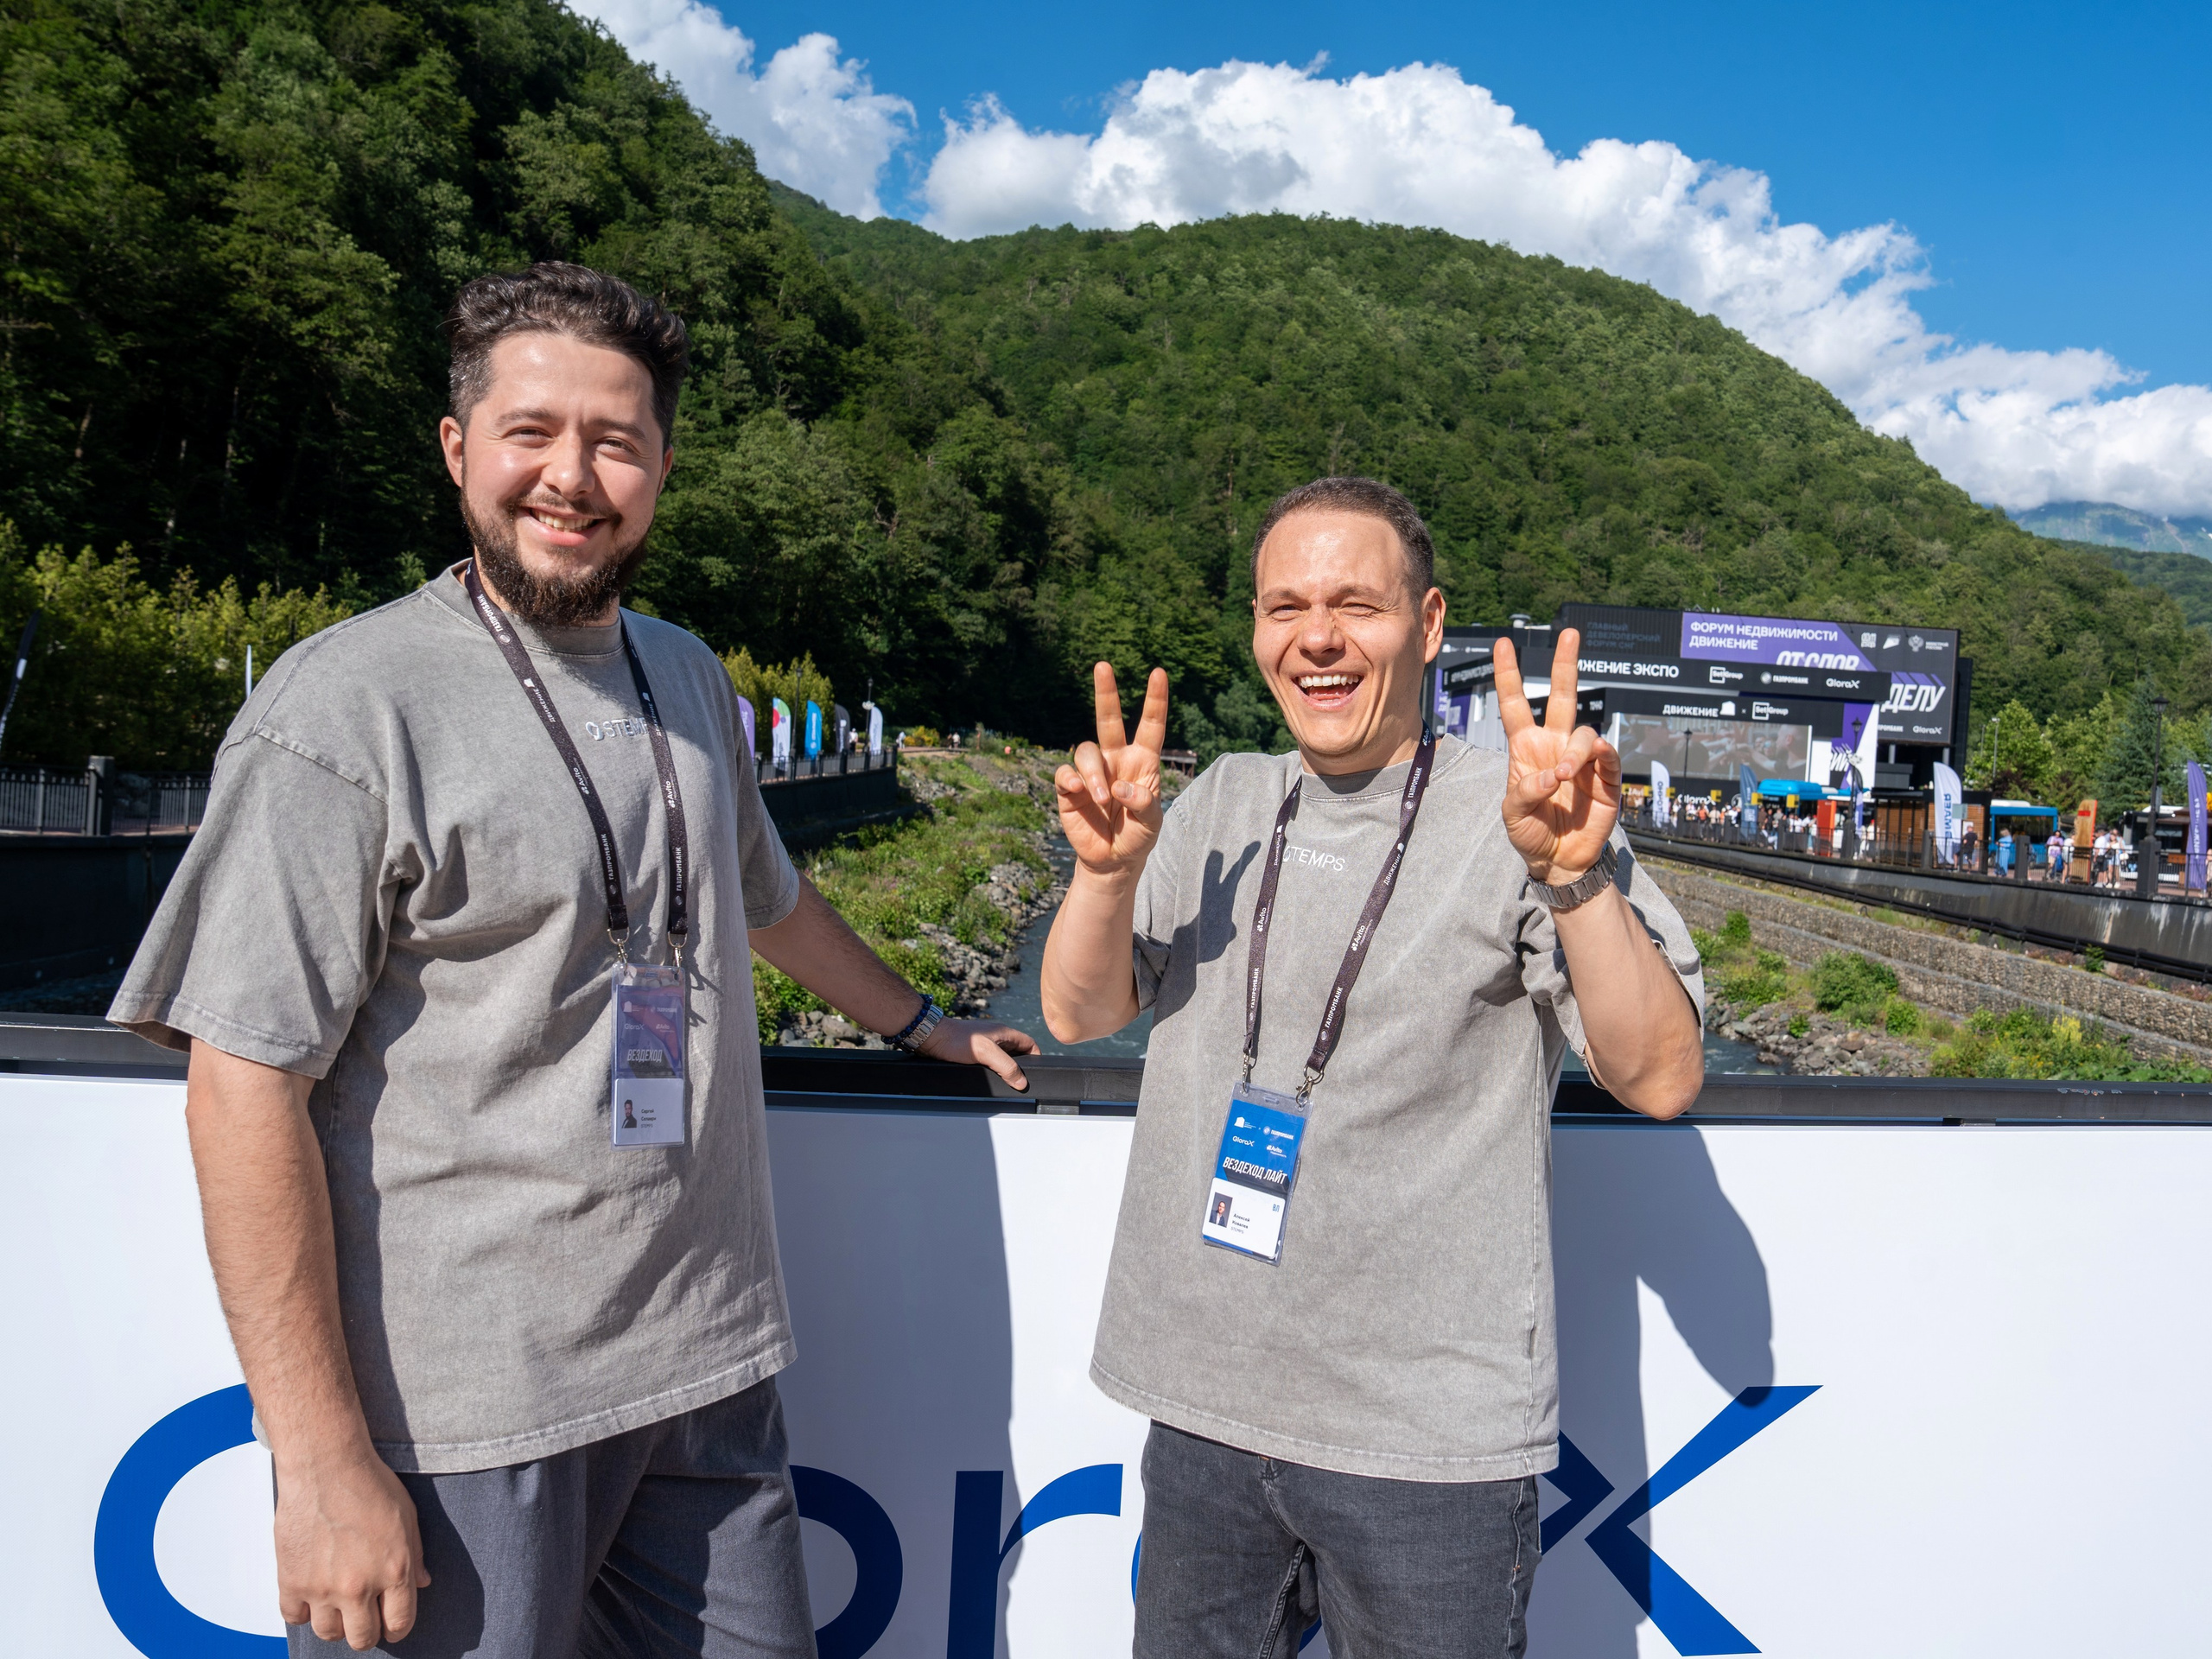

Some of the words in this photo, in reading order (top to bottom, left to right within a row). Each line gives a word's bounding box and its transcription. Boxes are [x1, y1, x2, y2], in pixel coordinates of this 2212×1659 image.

[1690, 621, 1734, 634] ФОРУМ
[1736, 625, 1838, 641] НЕДВИЖИМОСТИ
[1689, 635, 1758, 651] ДВИЖЕНИЕ
[1577, 658, 1631, 675] ИЖЕНИЕ
[1632, 663, 1680, 678] ЭКСПО
[1826, 677, 1860, 690] GloraX
[1880, 683, 1946, 714] ДЕЛУ
[1662, 704, 1719, 718] ДВИЖЕНИЕ
[1912, 725, 1943, 734] GloraX
[573, 767, 585, 789] Avito
[666, 780, 676, 800] Avito
[601, 834, 613, 880] ГАЗПРОМБАНК
[1383, 853, 1402, 886] ДВИЖЕНИЕ
[1355, 925, 1365, 944] Avito
[1250, 967, 1260, 1008] ГАЗПРОМБАНК
[1325, 987, 1344, 1028] ГАЗПРОМБАНК
[627, 1049, 663, 1063] ВЕЗДЕХОД
[1232, 1135, 1255, 1147] GloraX
[1223, 1156, 1265, 1179] ВЕЗДЕХОД
[1263, 1170, 1287, 1185] ЛАЙТ
